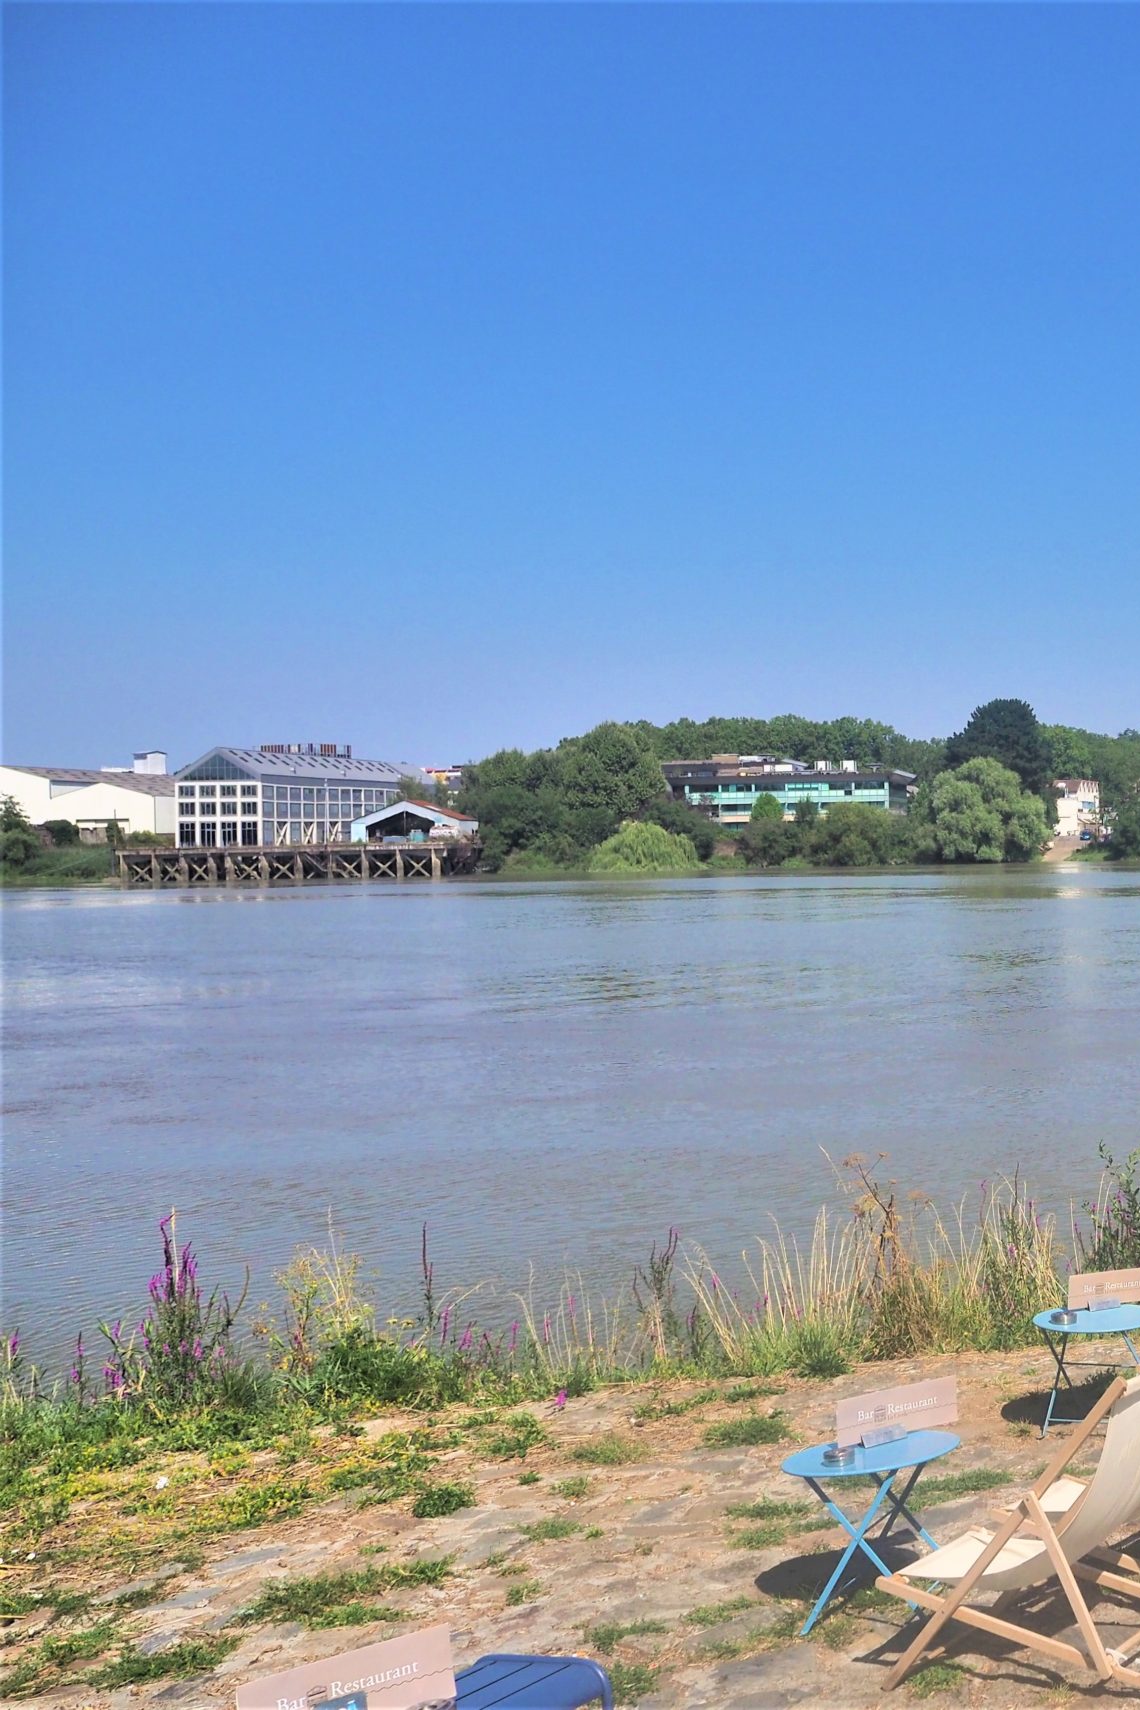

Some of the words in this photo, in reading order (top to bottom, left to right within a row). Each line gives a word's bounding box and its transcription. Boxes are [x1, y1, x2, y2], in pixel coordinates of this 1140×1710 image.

[857, 1409, 874, 1421] Bar
[887, 1396, 938, 1414] Restaurant
[276, 1696, 306, 1710] Bar
[330, 1661, 419, 1699] Restaurant
